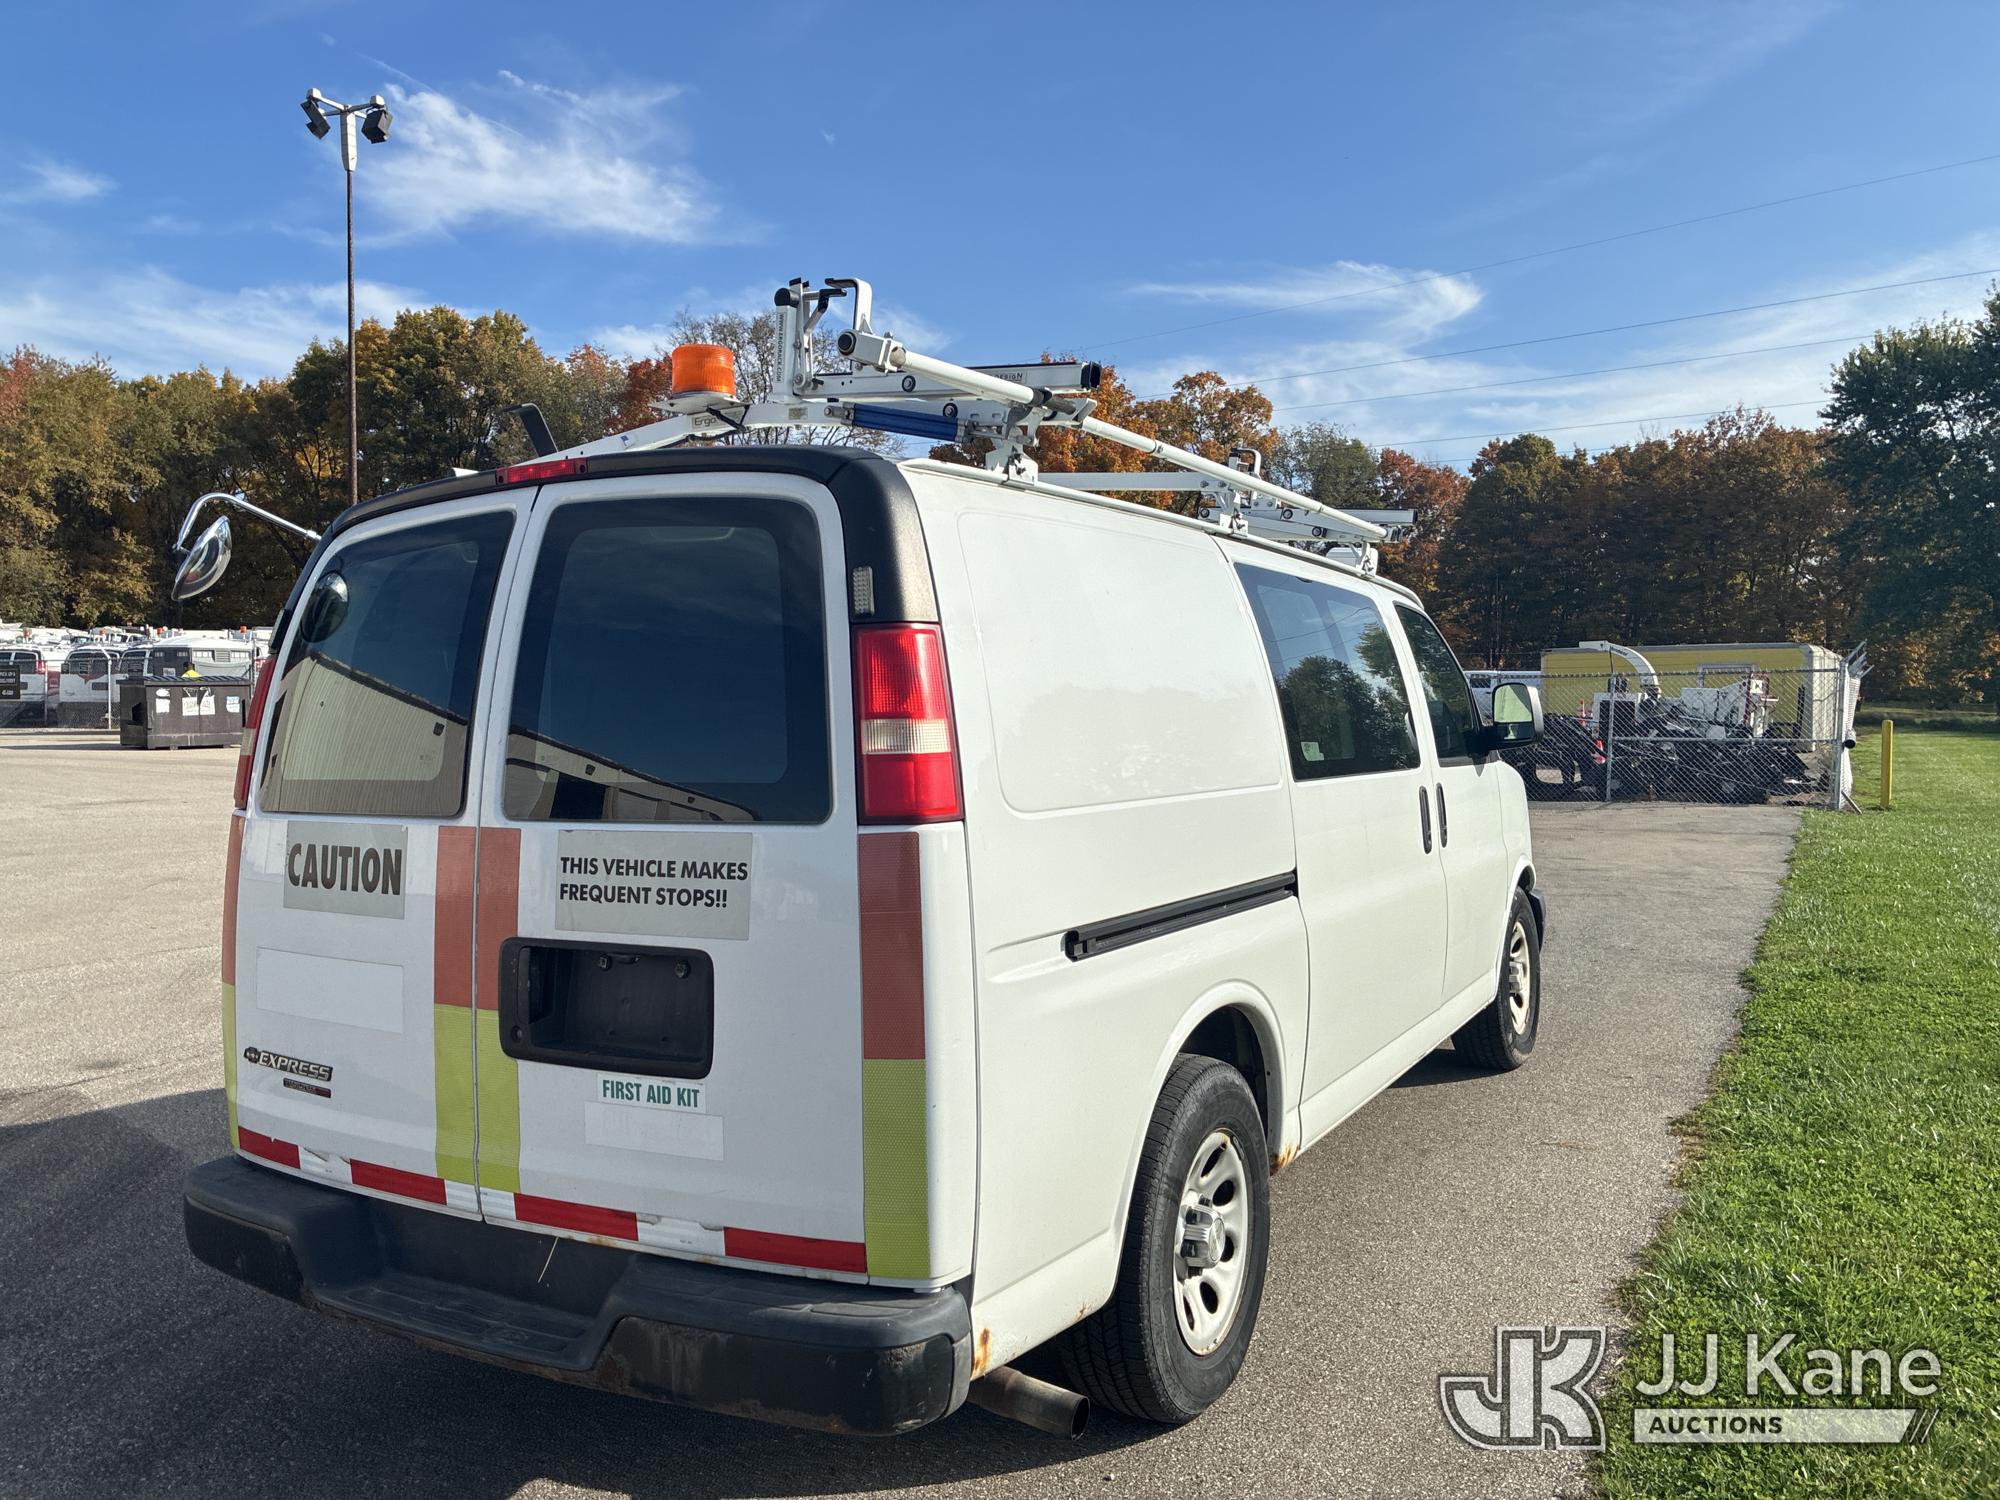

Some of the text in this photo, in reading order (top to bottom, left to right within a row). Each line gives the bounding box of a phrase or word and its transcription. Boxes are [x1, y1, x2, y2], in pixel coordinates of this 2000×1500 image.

[288, 843, 402, 895] CAUTION
[560, 857, 748, 881] THIS VEHICLE MAKES
[560, 883, 728, 908] FREQUENT STOPS!!
[259, 1052, 331, 1081] EXPRESS
[603, 1080, 700, 1108] FIRST AID KIT
